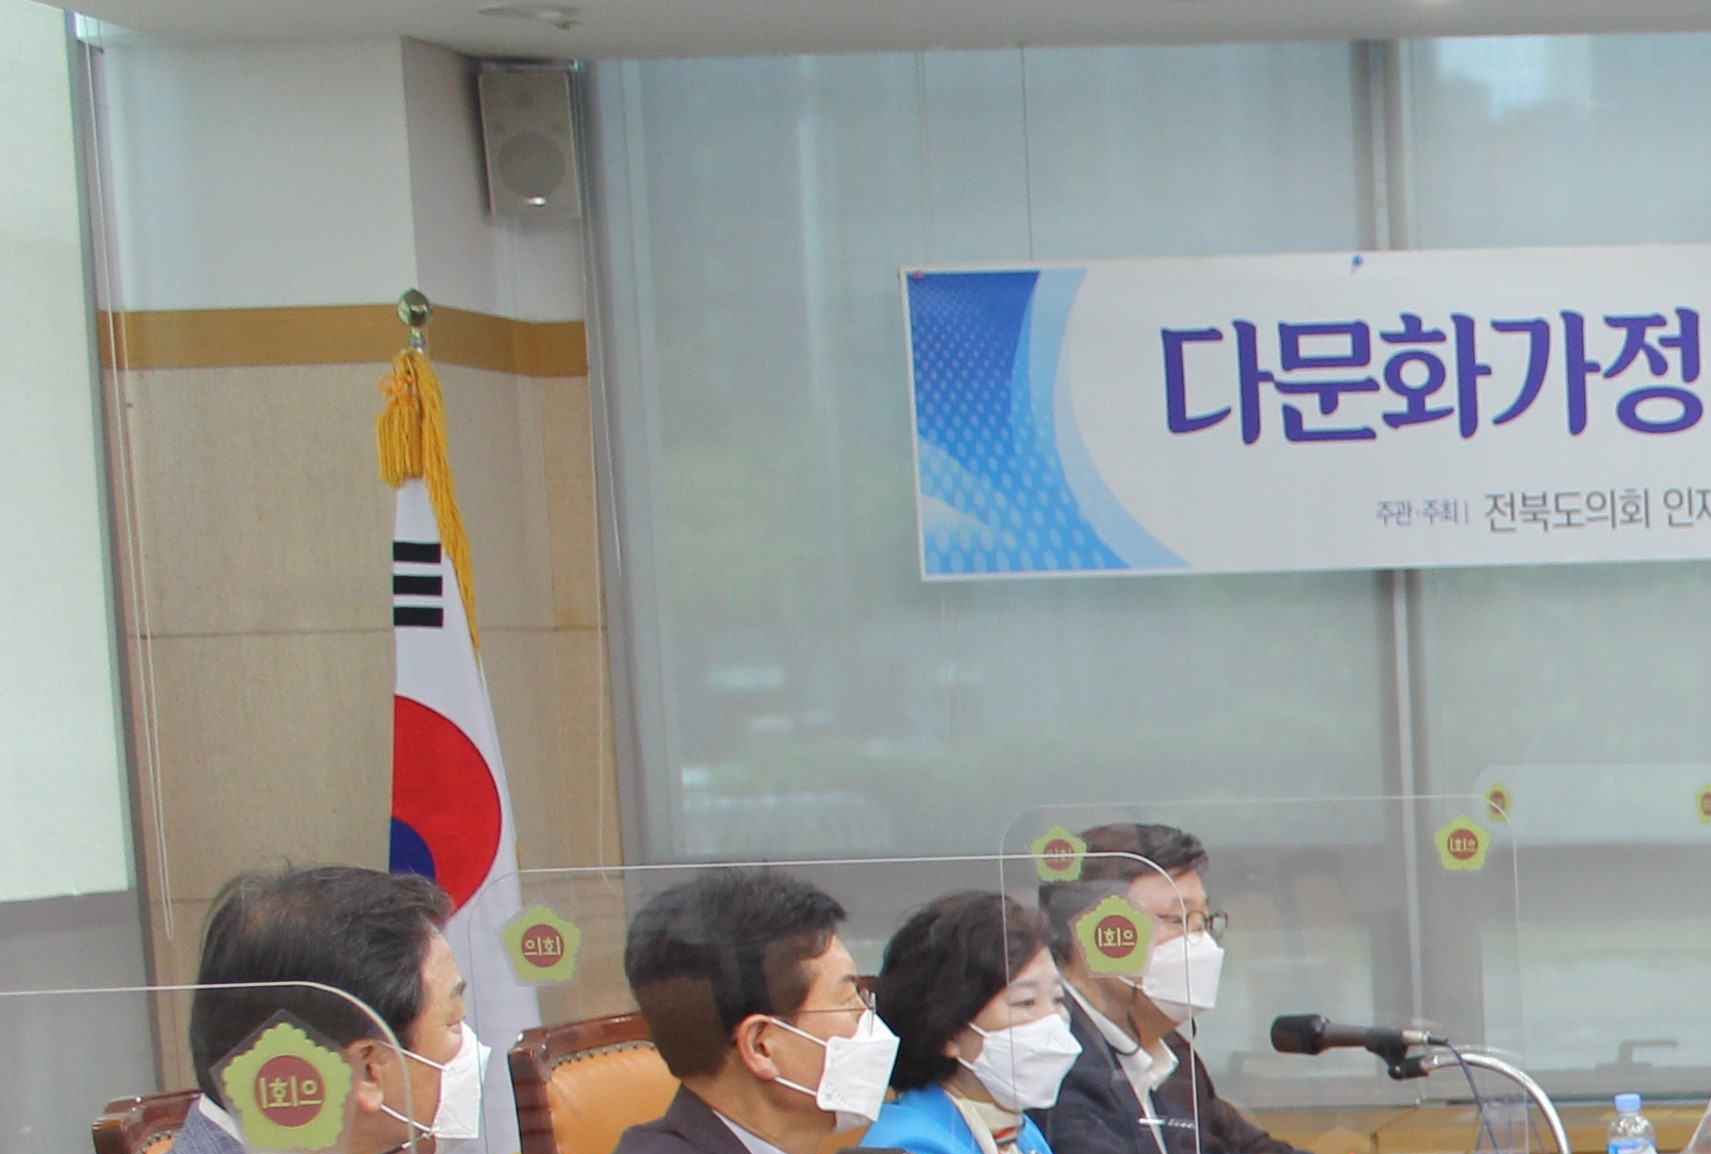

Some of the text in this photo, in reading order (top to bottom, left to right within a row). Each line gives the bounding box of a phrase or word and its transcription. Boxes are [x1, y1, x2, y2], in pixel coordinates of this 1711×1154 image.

[1161, 309, 1704, 445] 다문화가정
[1484, 486, 1651, 534] 전북도의회
[524, 935, 561, 956] 의회
